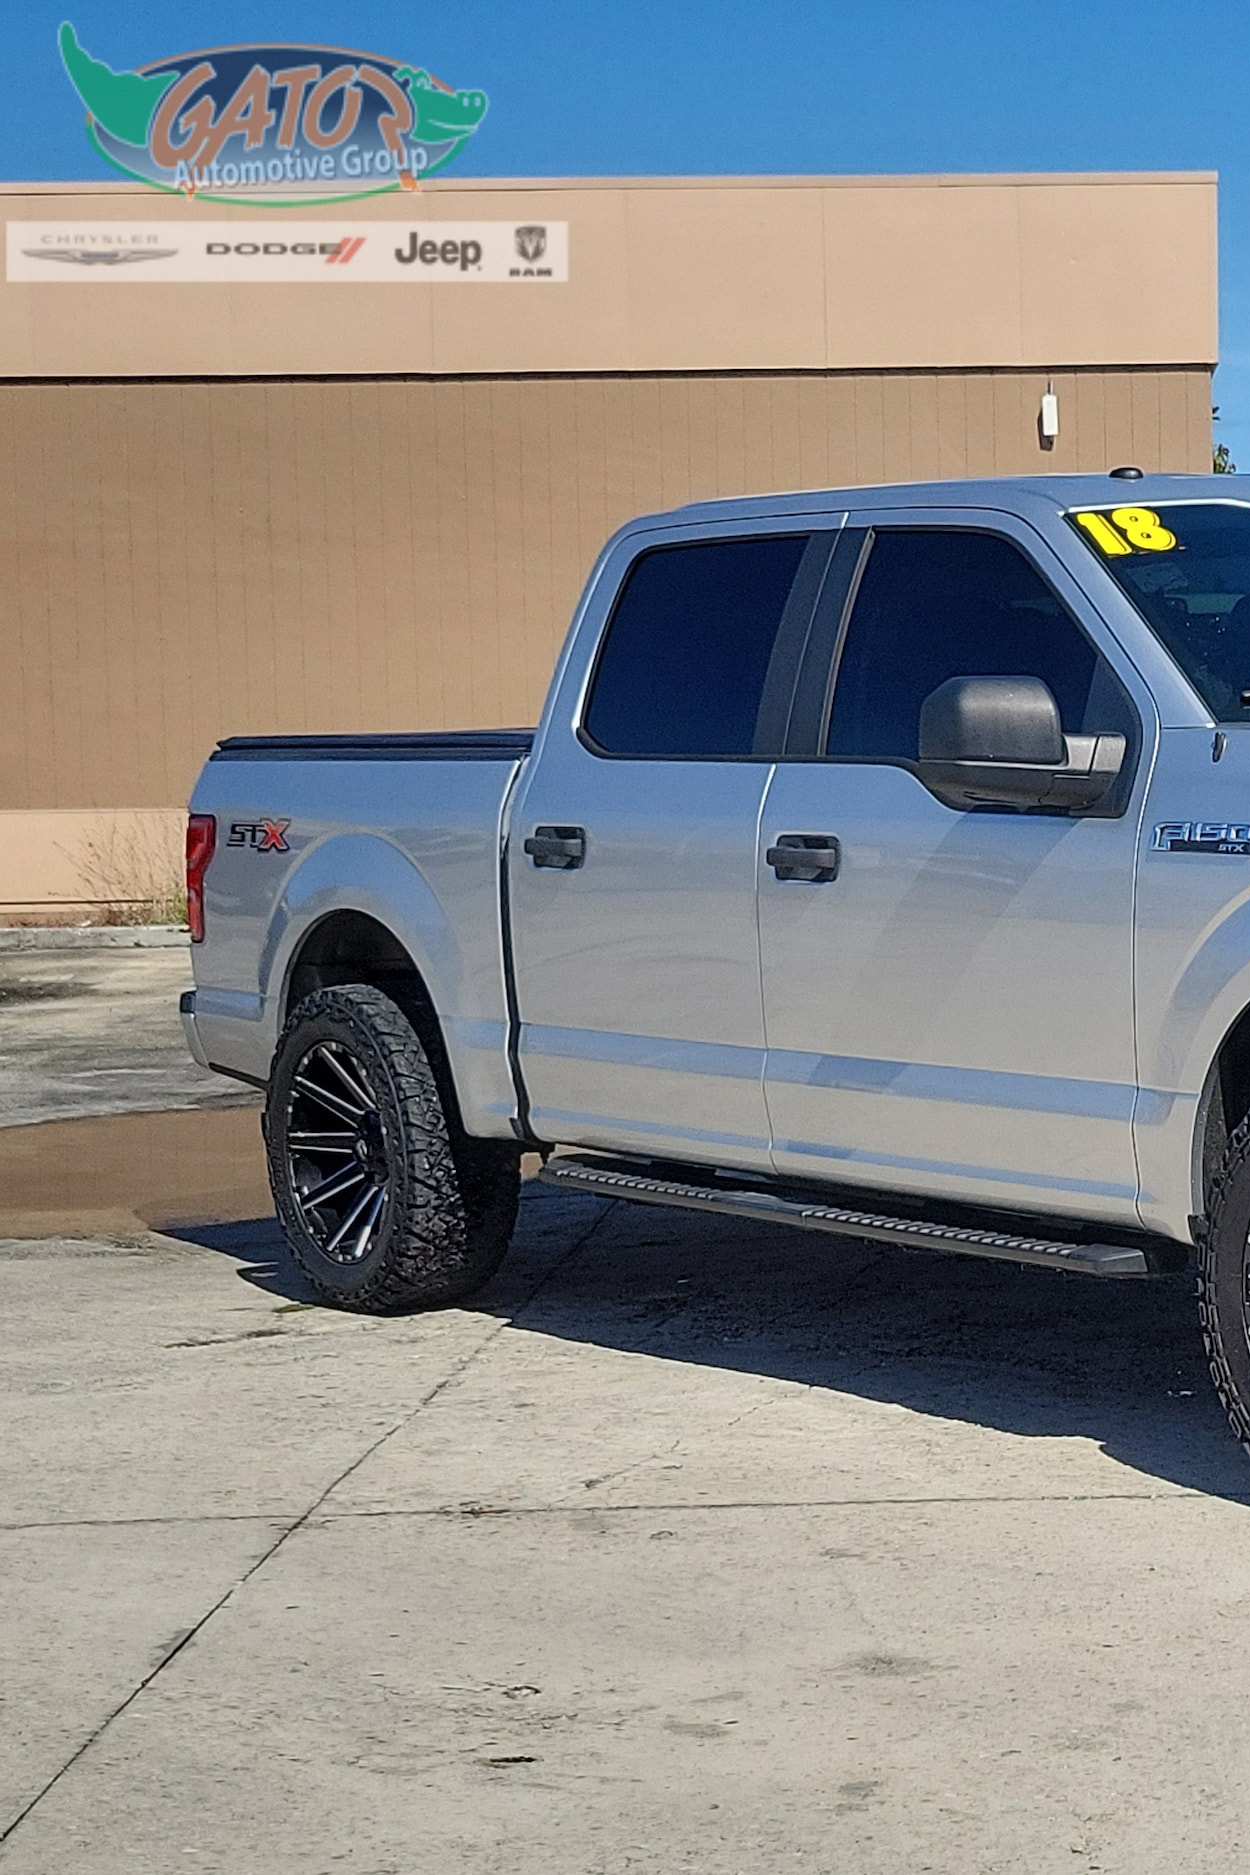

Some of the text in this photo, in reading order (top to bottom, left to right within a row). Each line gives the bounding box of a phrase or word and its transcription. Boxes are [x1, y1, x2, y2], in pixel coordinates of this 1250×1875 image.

[1077, 507, 1177, 556] 18
[227, 819, 291, 851] STX
[1218, 843, 1245, 852] STX
